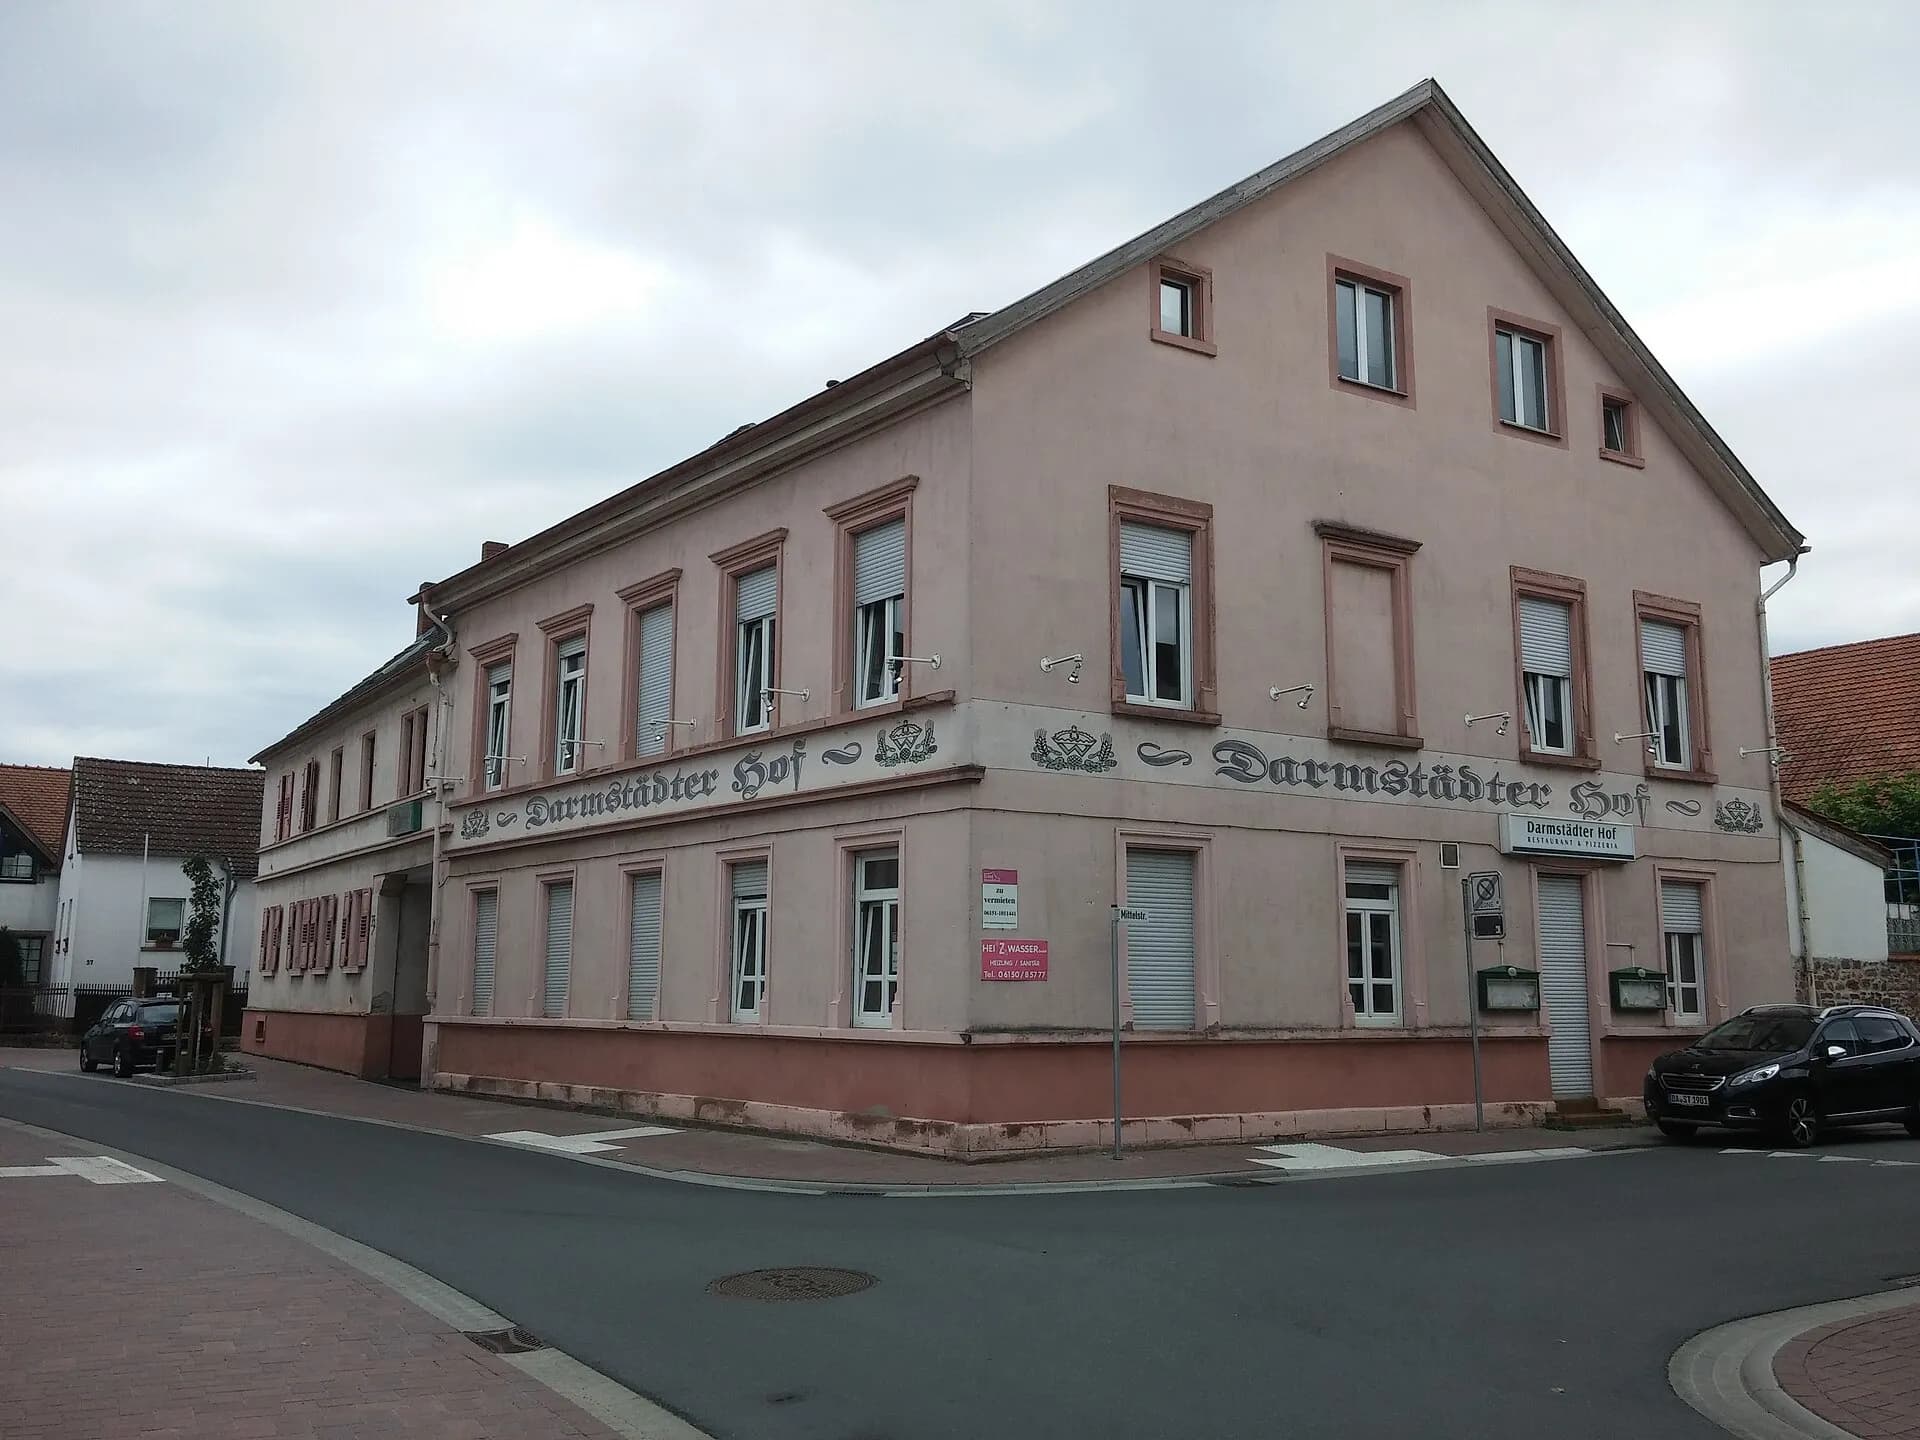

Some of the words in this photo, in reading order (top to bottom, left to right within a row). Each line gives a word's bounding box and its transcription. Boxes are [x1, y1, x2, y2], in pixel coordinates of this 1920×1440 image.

[525, 767, 719, 829] Darmstädter
[731, 738, 806, 800] Hof
[1212, 740, 1552, 809] Darmstädter
[1569, 780, 1651, 828] Hof
[1527, 821, 1594, 838] Darmstädter
[1598, 827, 1617, 840] Hof
[1527, 836, 1573, 846] RESTAURANT
[1585, 841, 1618, 849] PIZZERIA
[984, 896, 1016, 904] vermieten
[1120, 909, 1148, 920] Mittelstr.
[1007, 944, 1039, 953] WASSER
